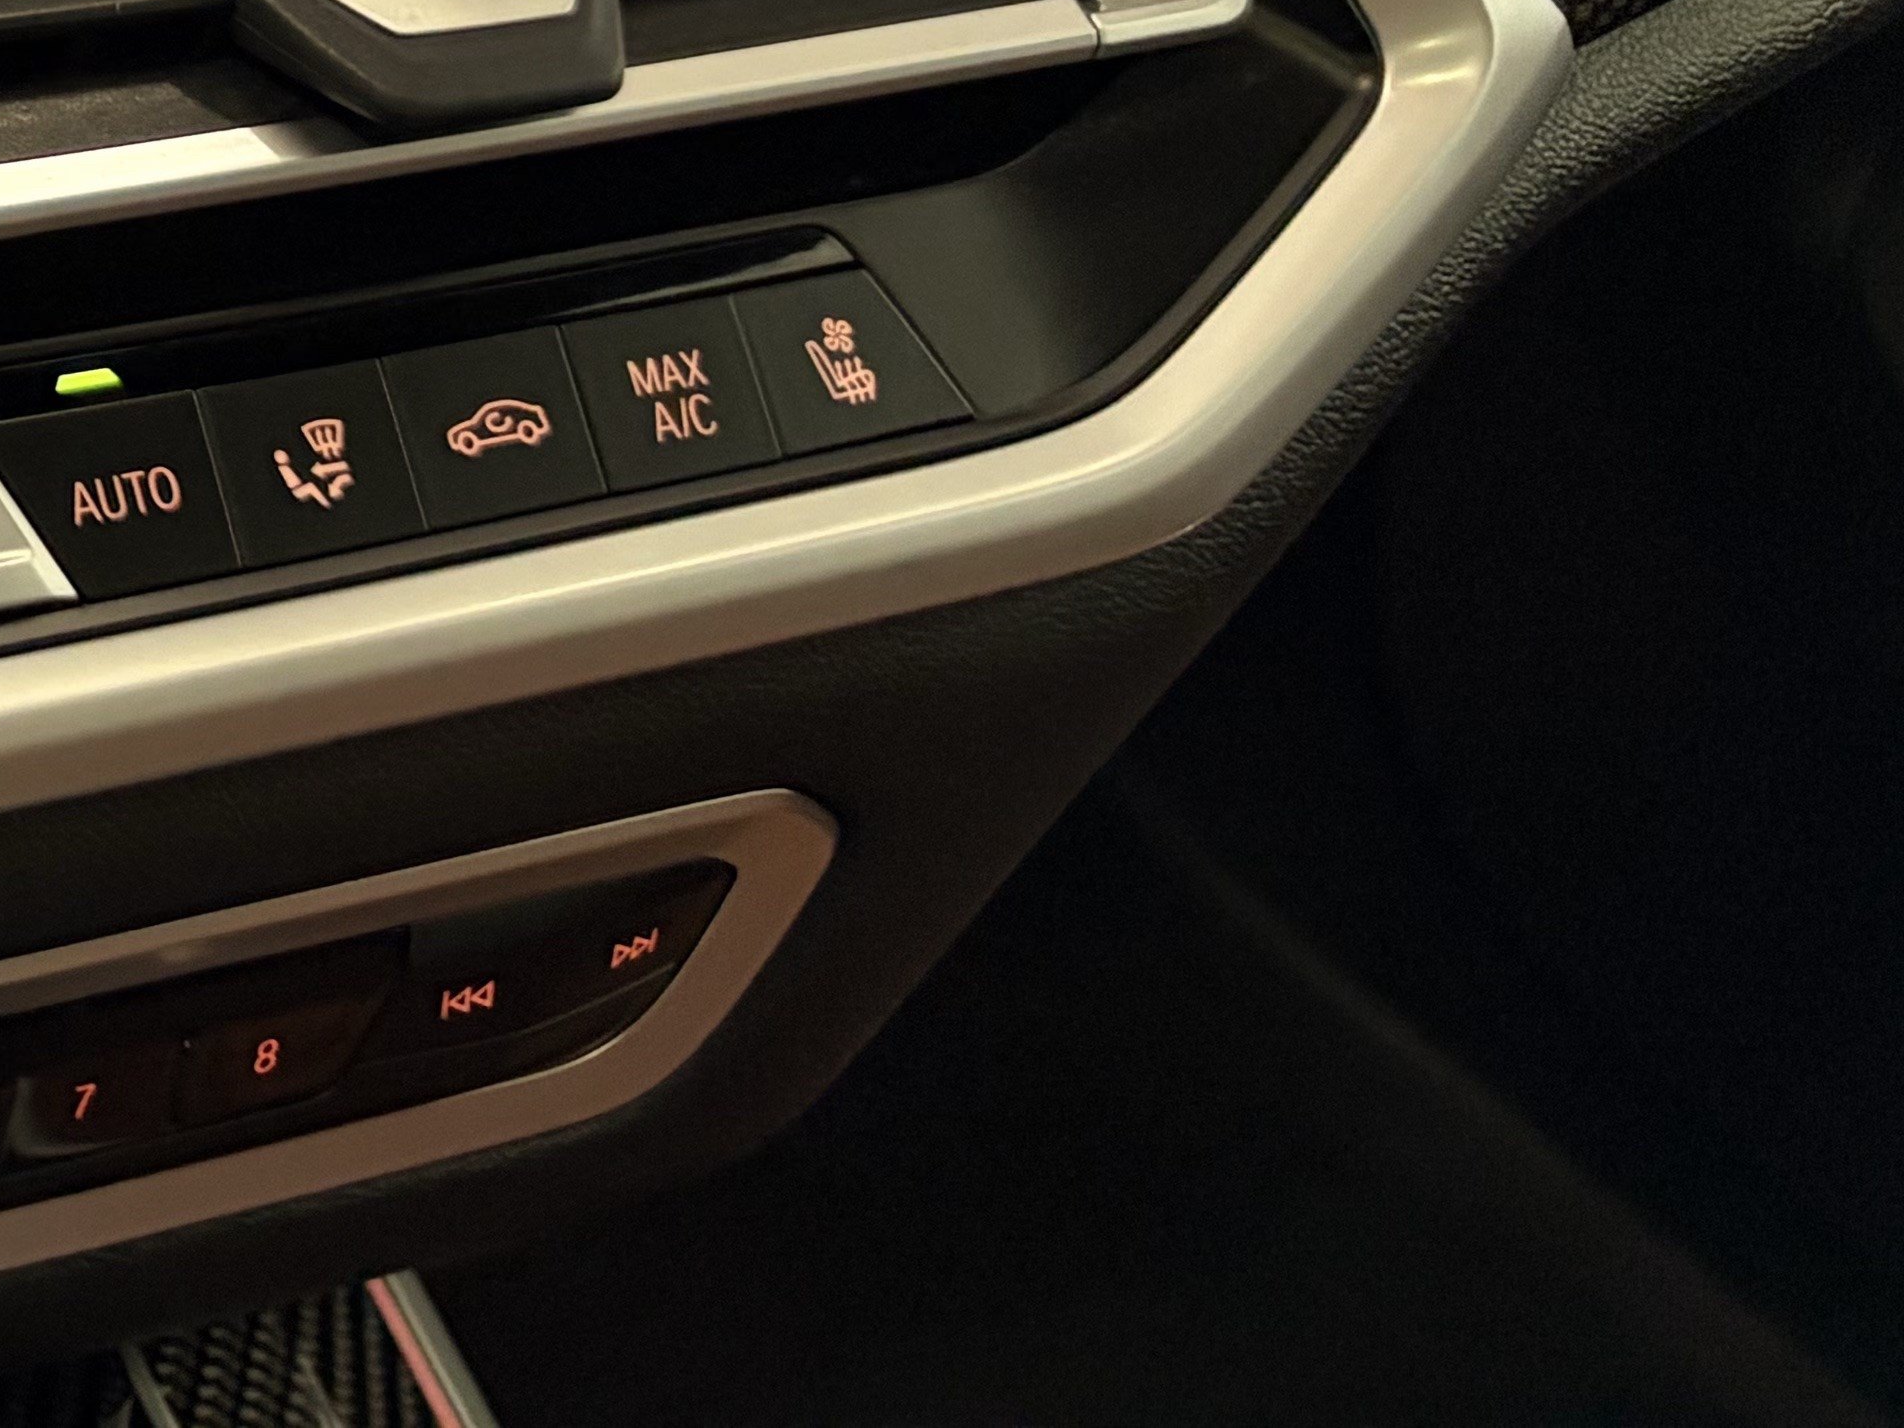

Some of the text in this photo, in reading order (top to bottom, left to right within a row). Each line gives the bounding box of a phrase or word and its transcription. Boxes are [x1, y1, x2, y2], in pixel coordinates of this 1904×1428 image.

[626, 350, 707, 397] MAX
[654, 393, 718, 442] A/C
[74, 466, 181, 526] AUTO
[254, 1039, 280, 1075] 8
[75, 1083, 97, 1118] 7
